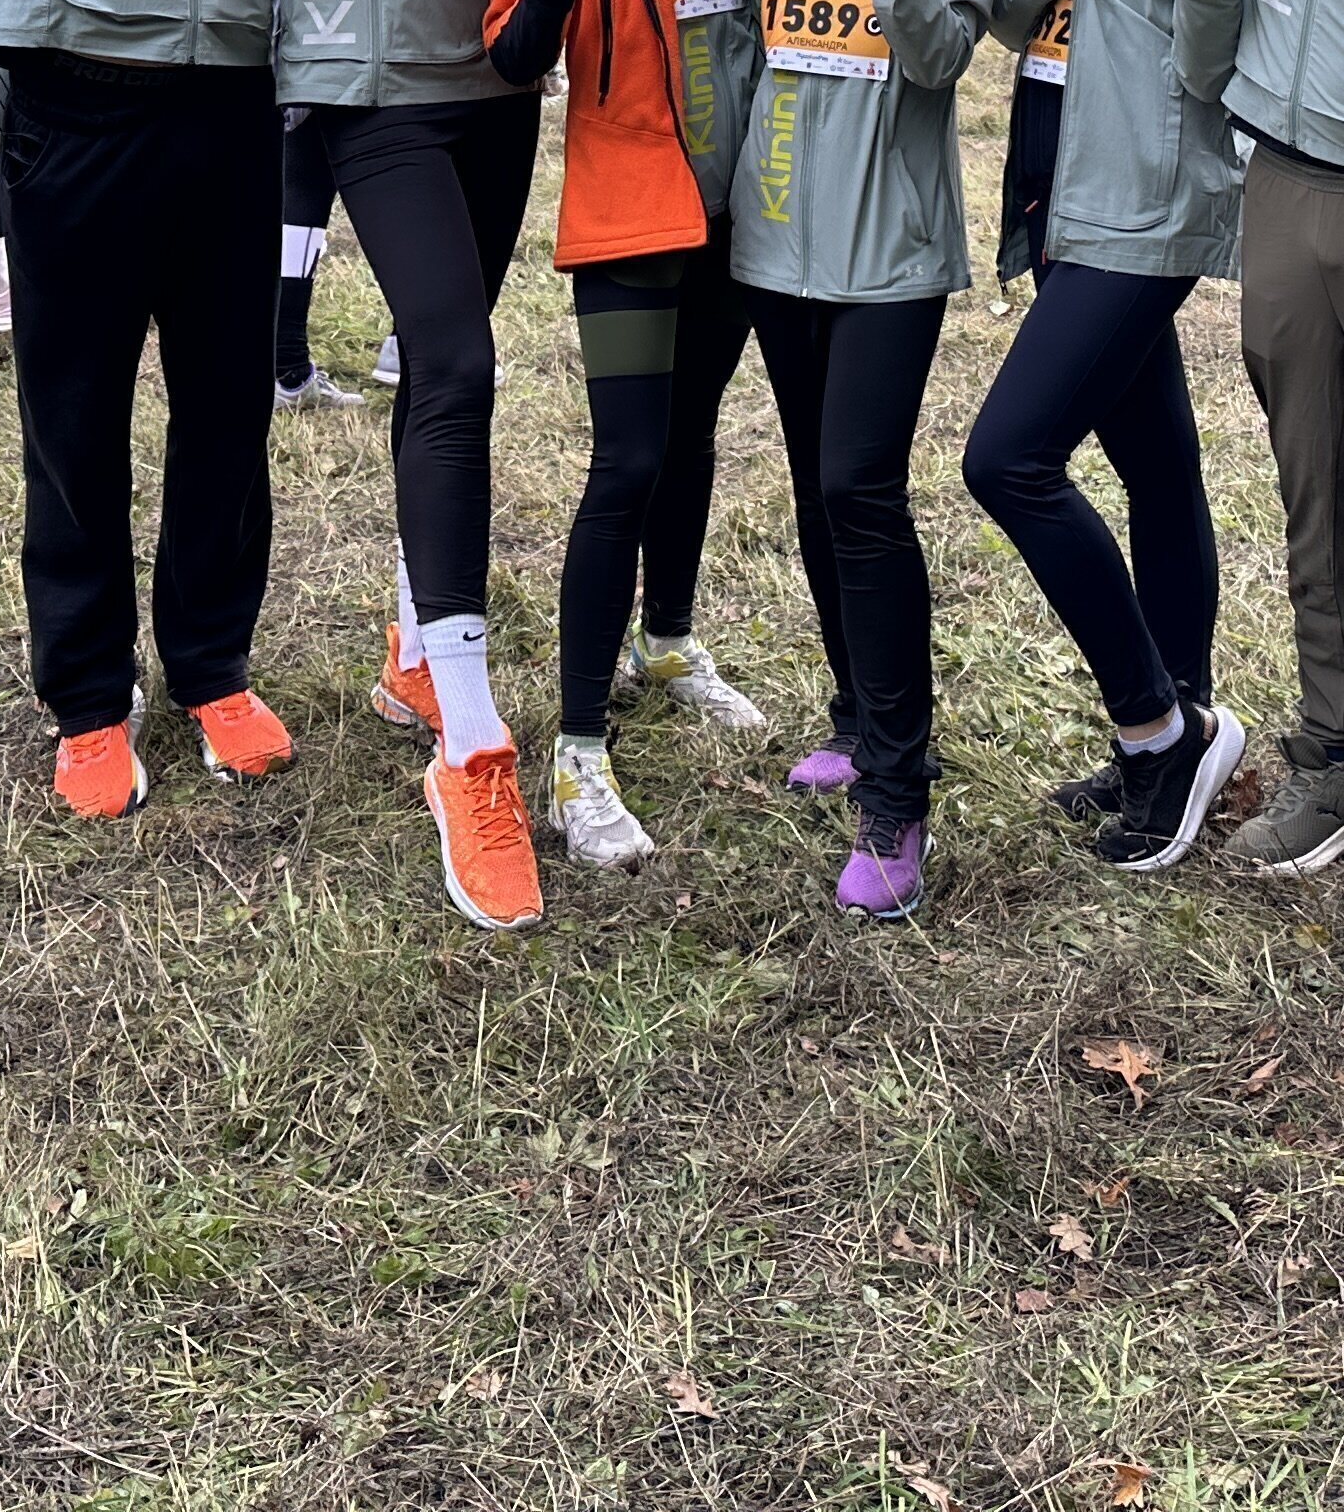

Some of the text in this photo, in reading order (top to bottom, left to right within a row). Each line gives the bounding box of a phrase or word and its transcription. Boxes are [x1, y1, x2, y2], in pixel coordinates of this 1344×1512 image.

[684, 26, 716, 156] Klinin
[786, 36, 848, 51] АЛЕКСАНДРА
[760, 92, 797, 223] Klinin
